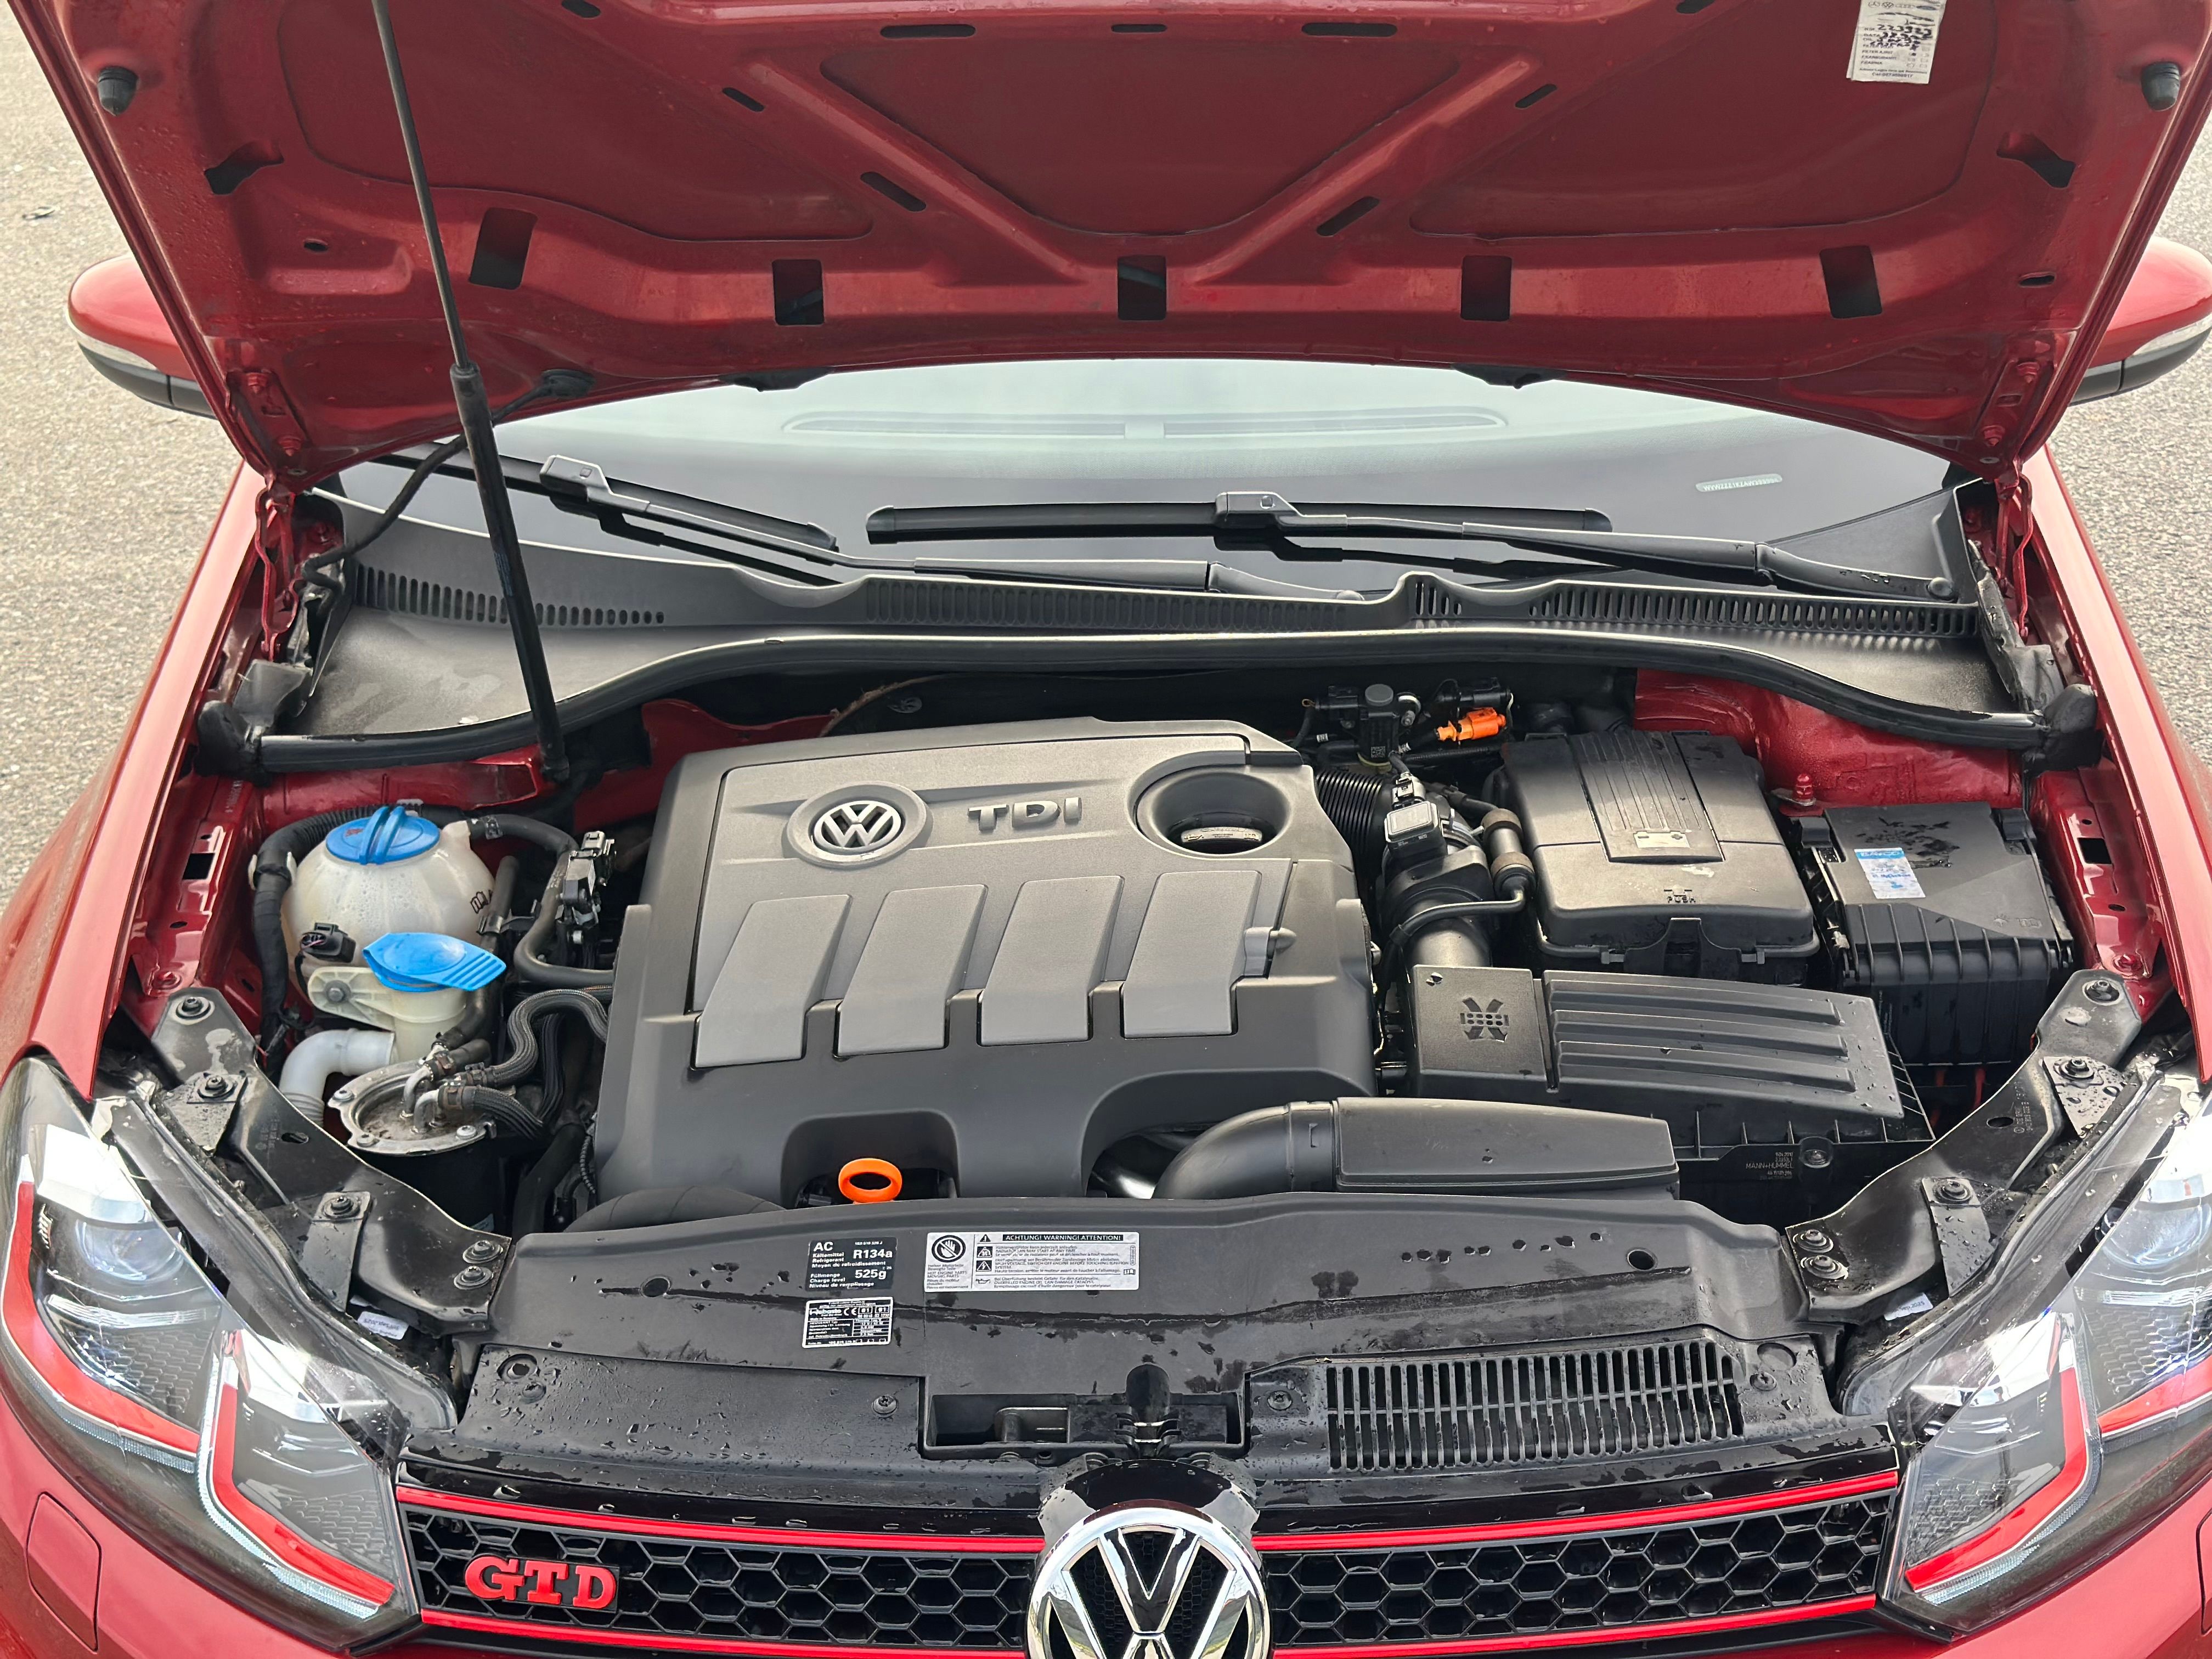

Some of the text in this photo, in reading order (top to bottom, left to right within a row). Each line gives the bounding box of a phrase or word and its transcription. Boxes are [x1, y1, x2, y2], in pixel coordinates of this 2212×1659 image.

[967, 797, 1082, 832] TDI
[814, 1242, 833, 1252] AC
[853, 1249, 893, 1259] R134a
[855, 1269, 887, 1280] 525g
[465, 1556, 617, 1609] GTD
